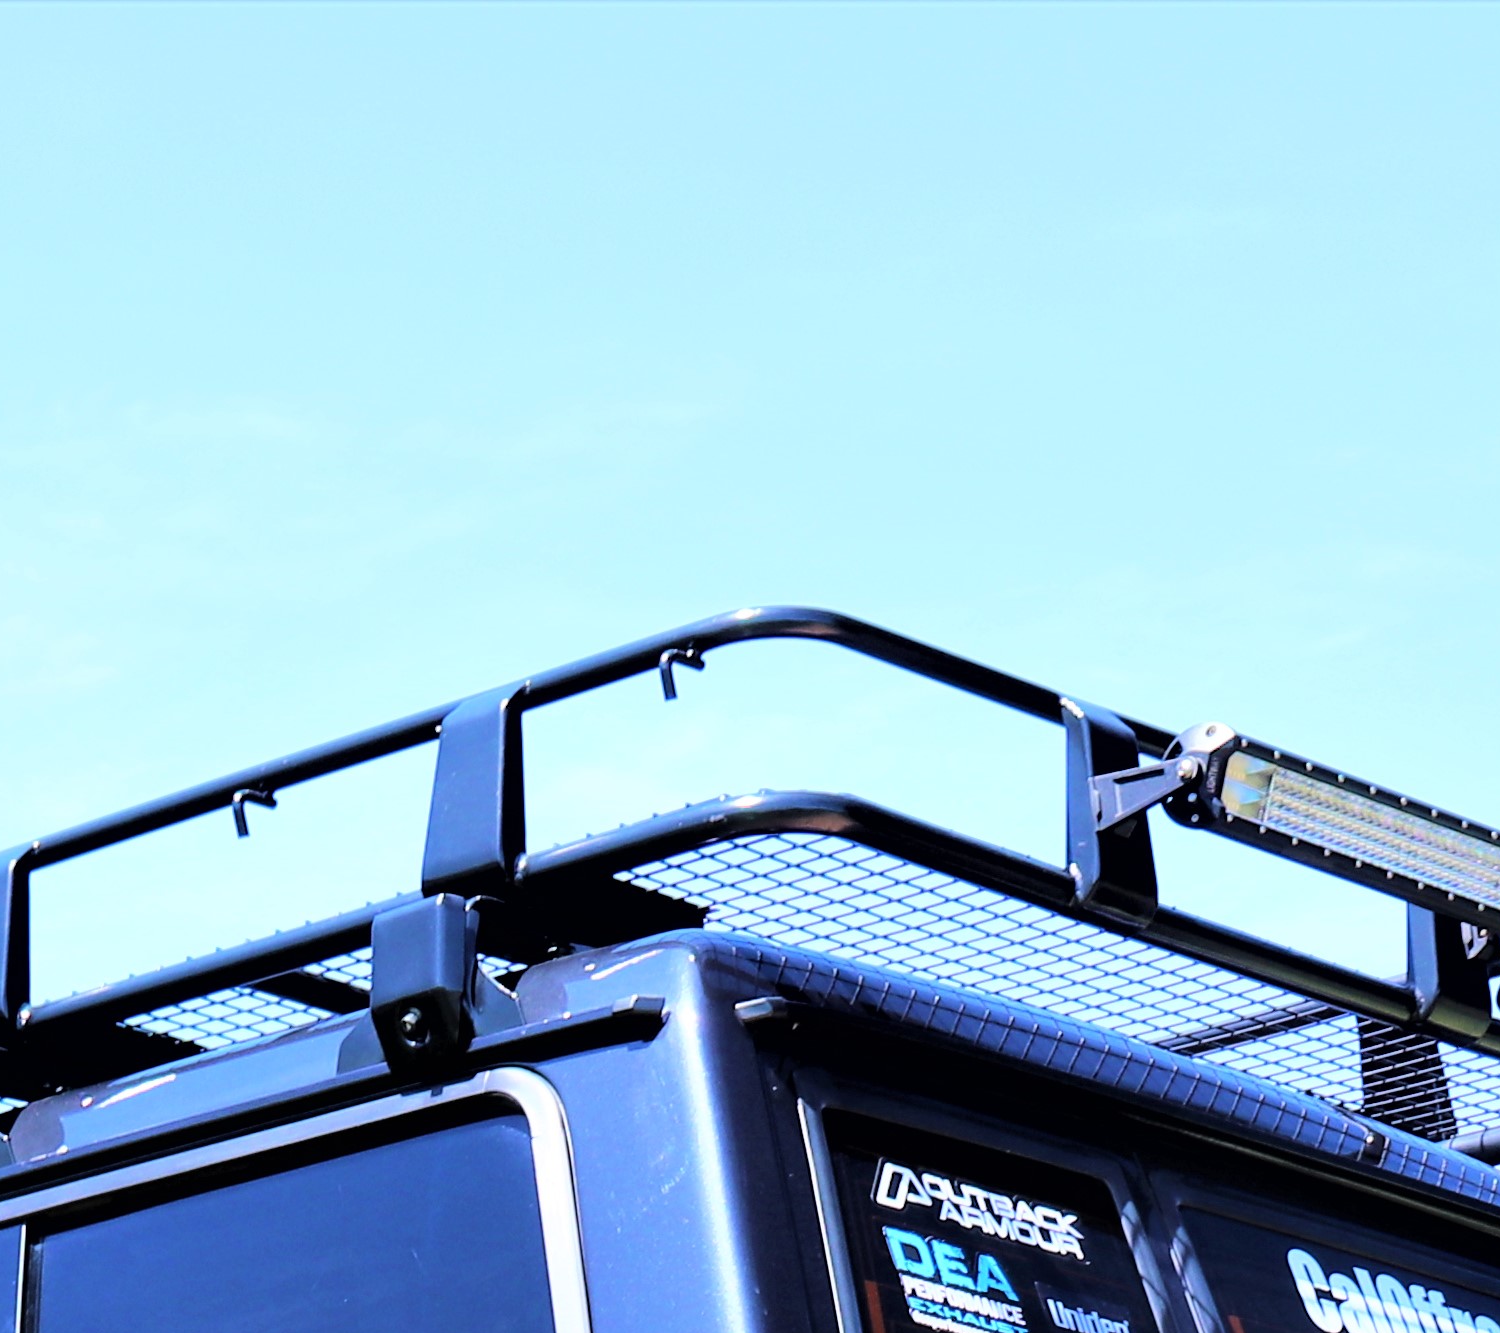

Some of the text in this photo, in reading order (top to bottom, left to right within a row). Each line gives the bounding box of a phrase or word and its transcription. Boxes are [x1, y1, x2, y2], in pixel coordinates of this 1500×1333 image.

[921, 1173, 1084, 1240] OUTBACK
[940, 1201, 1084, 1260] ARMOUR
[885, 1226, 1019, 1302] DEA
[900, 1273, 1026, 1326] PERFORMANCE
